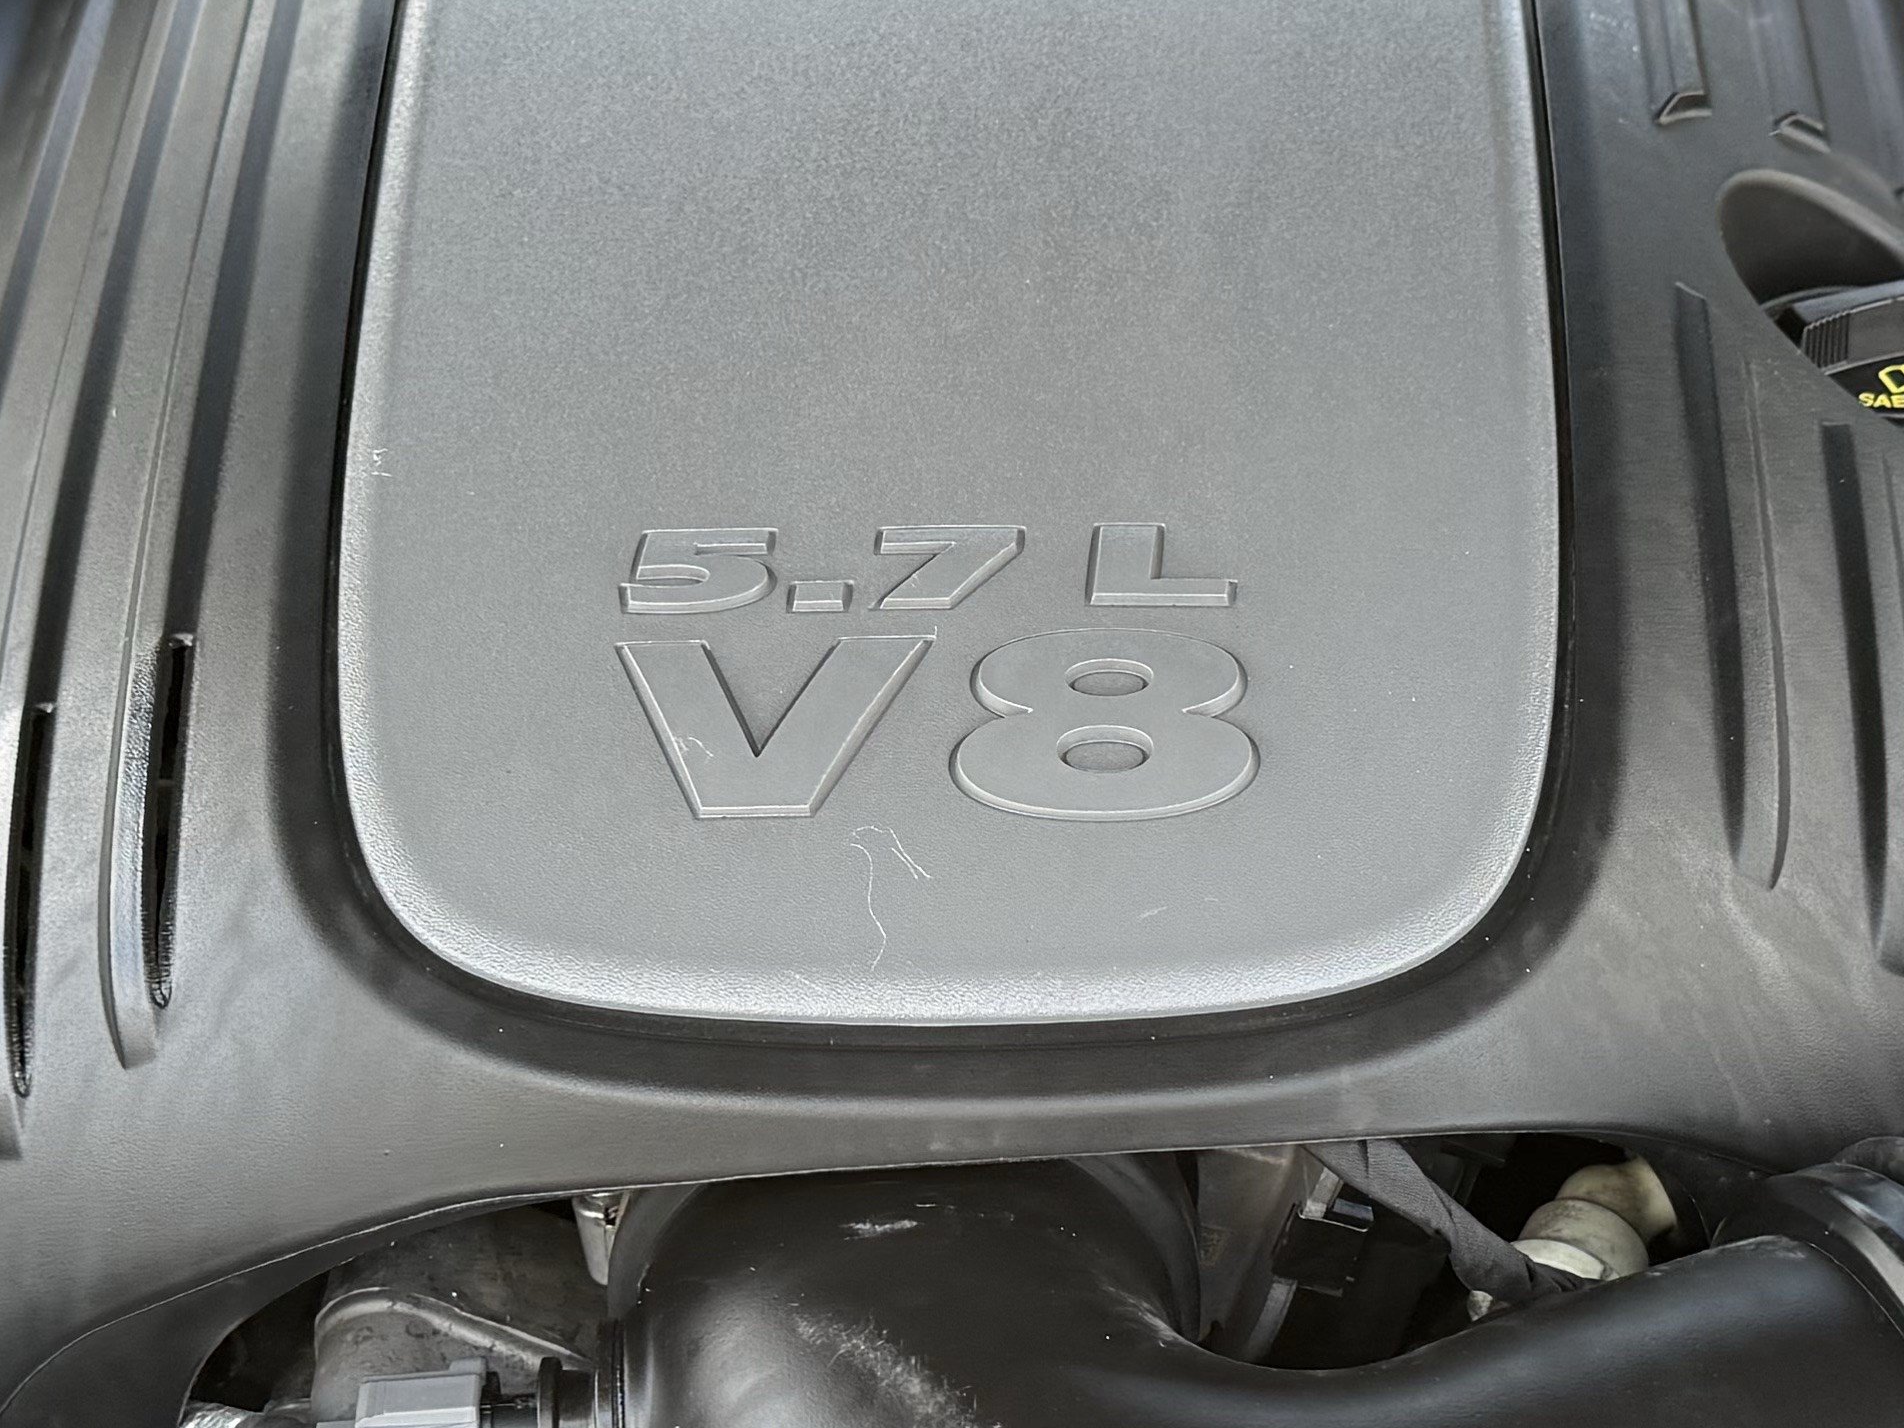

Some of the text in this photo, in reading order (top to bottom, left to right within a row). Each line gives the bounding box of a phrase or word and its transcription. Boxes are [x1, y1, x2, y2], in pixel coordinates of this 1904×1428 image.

[618, 522, 1238, 613] 5.7 L
[614, 627, 1261, 822] V8
